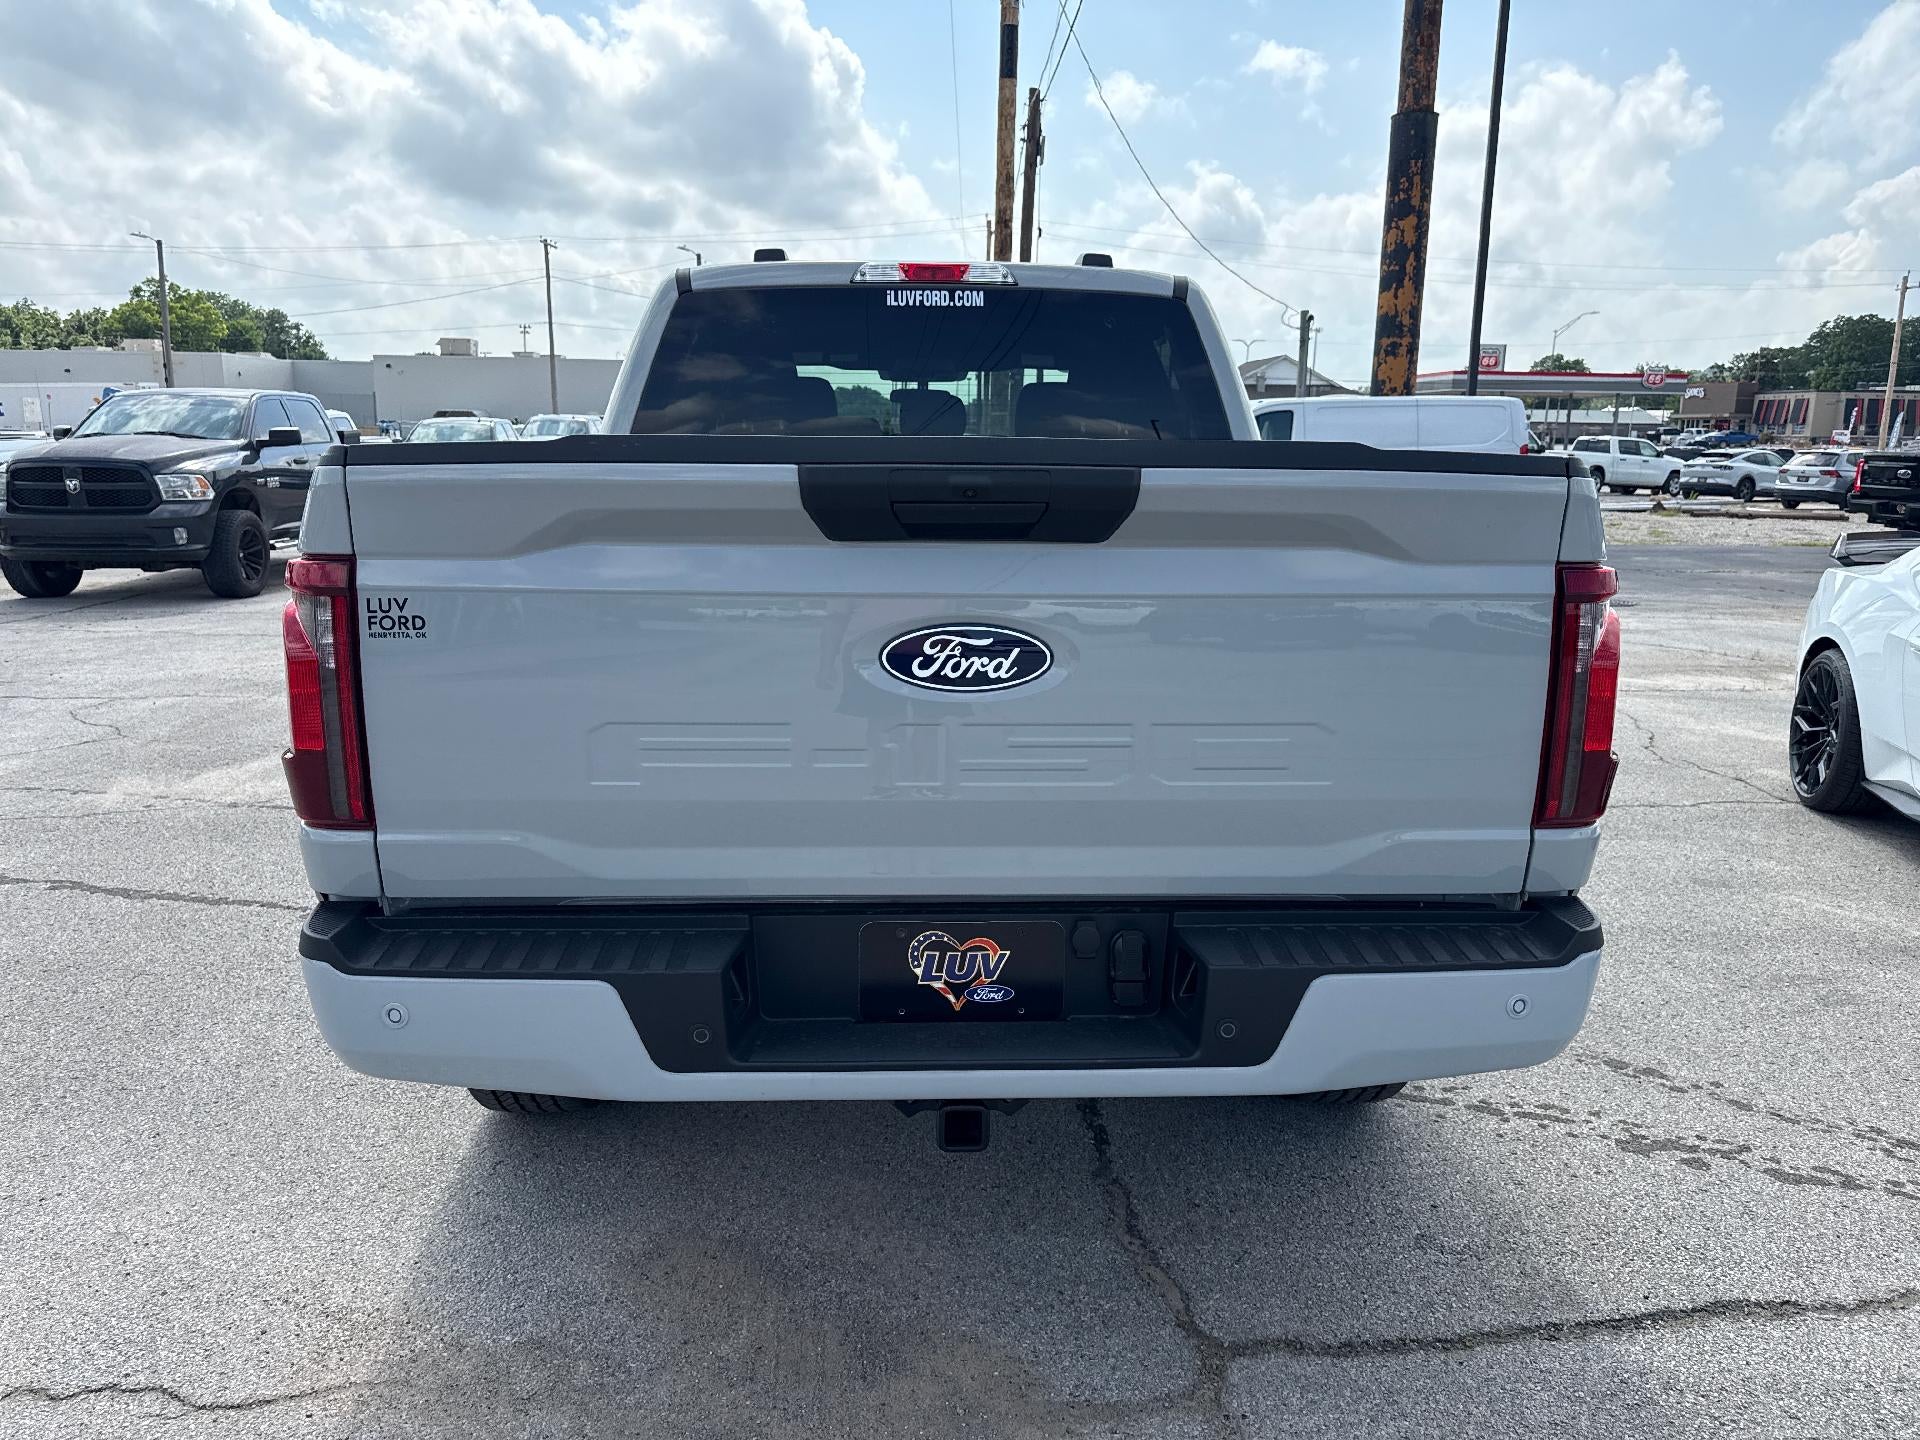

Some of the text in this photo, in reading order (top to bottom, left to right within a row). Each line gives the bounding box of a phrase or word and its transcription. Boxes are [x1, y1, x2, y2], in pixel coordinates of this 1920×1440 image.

[886, 290, 985, 307] iLUVFORD.COM
[1481, 356, 1497, 366] 66
[1647, 374, 1663, 384] 66
[366, 597, 409, 614] LUV
[367, 615, 426, 631] FORD
[368, 631, 427, 640] HENRYETTA, OK
[911, 634, 1021, 679] Ford
[587, 721, 1335, 787] F-150
[917, 949, 1011, 985] LUV
[973, 987, 1005, 1001] Ford
